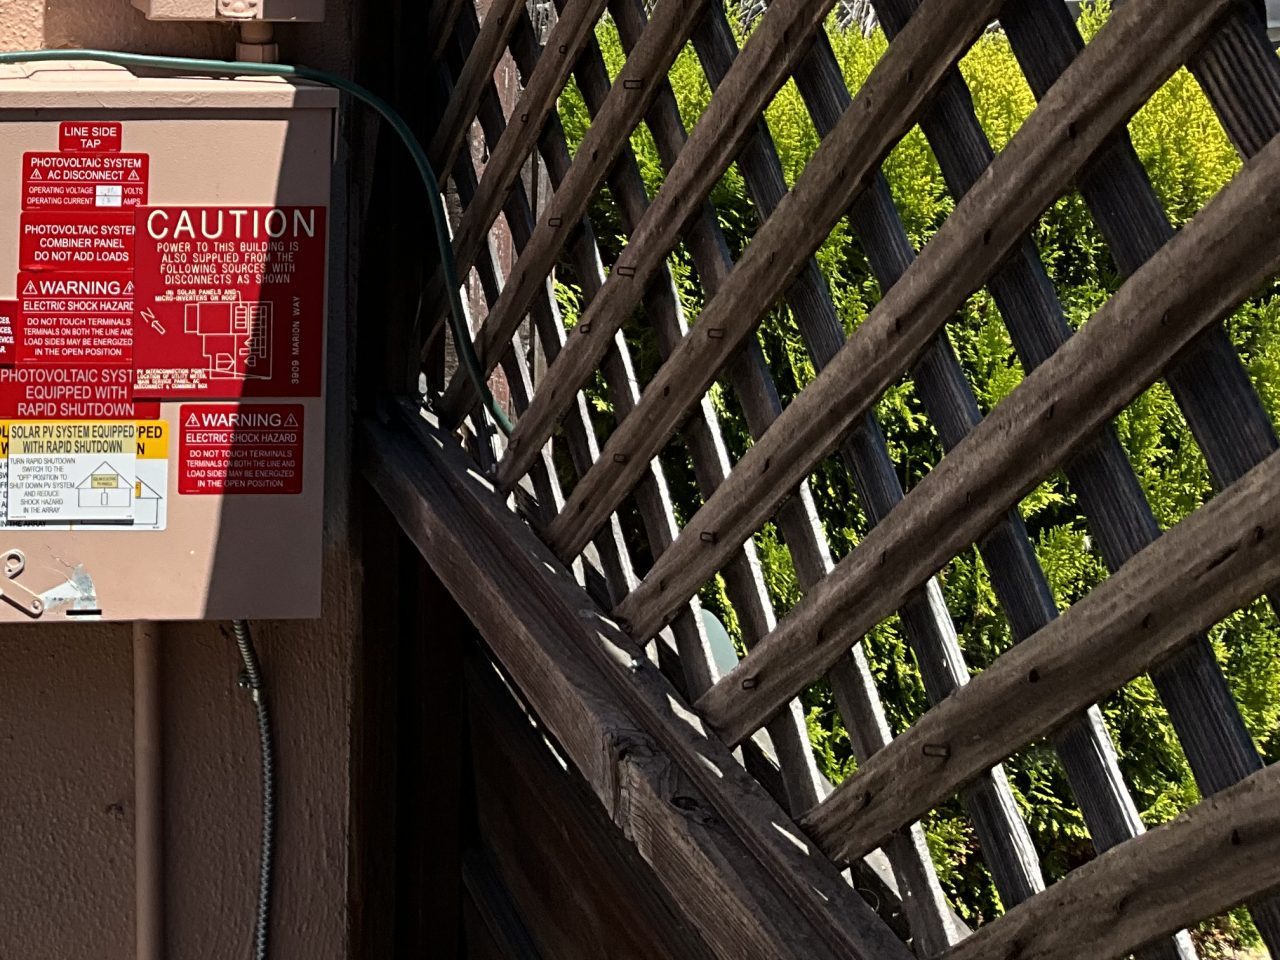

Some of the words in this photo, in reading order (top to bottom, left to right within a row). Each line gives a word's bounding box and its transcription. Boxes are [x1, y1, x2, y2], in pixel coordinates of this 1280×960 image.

[65, 127, 89, 137] LINE
[92, 127, 117, 137] SIDE
[80, 139, 101, 148] TAP
[31, 157, 101, 168] PHOTOVOLTAIC
[104, 158, 142, 168] SYSTEM
[47, 170, 61, 180] AC
[63, 170, 124, 180] DISCONNECT
[29, 186, 64, 194] OPERATING
[124, 187, 144, 195] VOLTS
[27, 197, 62, 205] OPERATING
[147, 209, 315, 239] CAUTION
[25, 225, 99, 235] PHOTOVOLTAIC
[40, 238, 92, 248] COMBINER
[94, 239, 125, 248] PANEL
[157, 242, 191, 253] POWER
[197, 242, 209, 253] TO
[214, 242, 235, 253] THIS
[240, 241, 284, 253] BUILDING
[289, 241, 299, 251] IS
[34, 251, 49, 261] DO
[52, 251, 72, 261] NOT
[73, 252, 94, 261] ADD
[96, 252, 129, 261] LOADS
[161, 252, 187, 264] ALSO
[192, 252, 239, 263] SUPPLIED
[245, 252, 270, 263] FROM
[277, 252, 294, 262] THE
[160, 263, 216, 274] FOLLOWING
[222, 263, 266, 274] SOURCES
[272, 262, 296, 273] WITH
[165, 274, 232, 285] DISCONNECTS
[237, 274, 250, 285] AS
[255, 273, 290, 284] SHOWN
[40, 281, 121, 295] WARNING
[23, 301, 65, 311] ELECTRIC
[67, 301, 98, 311] SHOCK
[100, 302, 134, 311] HAZARD
[292, 296, 301, 317] WAY
[27, 318, 39, 326] DO
[41, 318, 57, 326] NOT
[59, 318, 86, 326] TOUCH
[88, 318, 131, 326] TERMINALS
[24, 328, 60, 336] TERMINALS
[61, 328, 71, 336] ON
[72, 328, 90, 336] BOTH
[91, 328, 104, 336] THE
[105, 328, 119, 336] LINE
[24, 338, 43, 346] LOAD
[44, 338, 65, 346] SIDES
[66, 338, 81, 346] MAY
[82, 338, 92, 346] BE
[93, 338, 133, 346] ENERGIZED
[292, 320, 300, 355] MARION
[35, 348, 43, 356] IN
[44, 348, 60, 356] THE
[62, 348, 84, 356] OPEN
[85, 348, 122, 356] POSITION
[1, 369, 98, 383] PHOTOVOLTAIC
[292, 360, 300, 384] 3909
[26, 386, 91, 400] EQUIPPED
[95, 386, 128, 400] WITH
[18, 402, 57, 416] RAPID
[60, 403, 135, 417] SHUTDOWN
[201, 413, 282, 427] WARNING
[12, 425, 40, 439] SOLAR
[43, 425, 55, 439] PV
[56, 425, 90, 439] SYSTEM
[92, 425, 134, 439] EQUIPPED
[186, 433, 228, 443] ELECTRIC
[230, 433, 259, 443] SHOCK
[262, 433, 297, 443] HAZARD
[23, 441, 44, 454] WITH
[46, 441, 71, 454] RAPID
[74, 440, 123, 453] SHUTDOWN
[190, 450, 202, 458] DO
[203, 450, 219, 458] NOT
[221, 450, 248, 458] TOUCH
[250, 450, 293, 458] TERMINALS
[187, 460, 222, 468] TERMINALS
[223, 460, 233, 468] ON
[234, 460, 252, 468] BOTH
[187, 470, 205, 478] LOAD
[207, 470, 227, 478] SIDES
[229, 470, 243, 478] MAY
[198, 480, 206, 488] IN
[207, 480, 222, 488] THE
[224, 480, 246, 488] OPEN
[247, 480, 284, 488] POSITION
